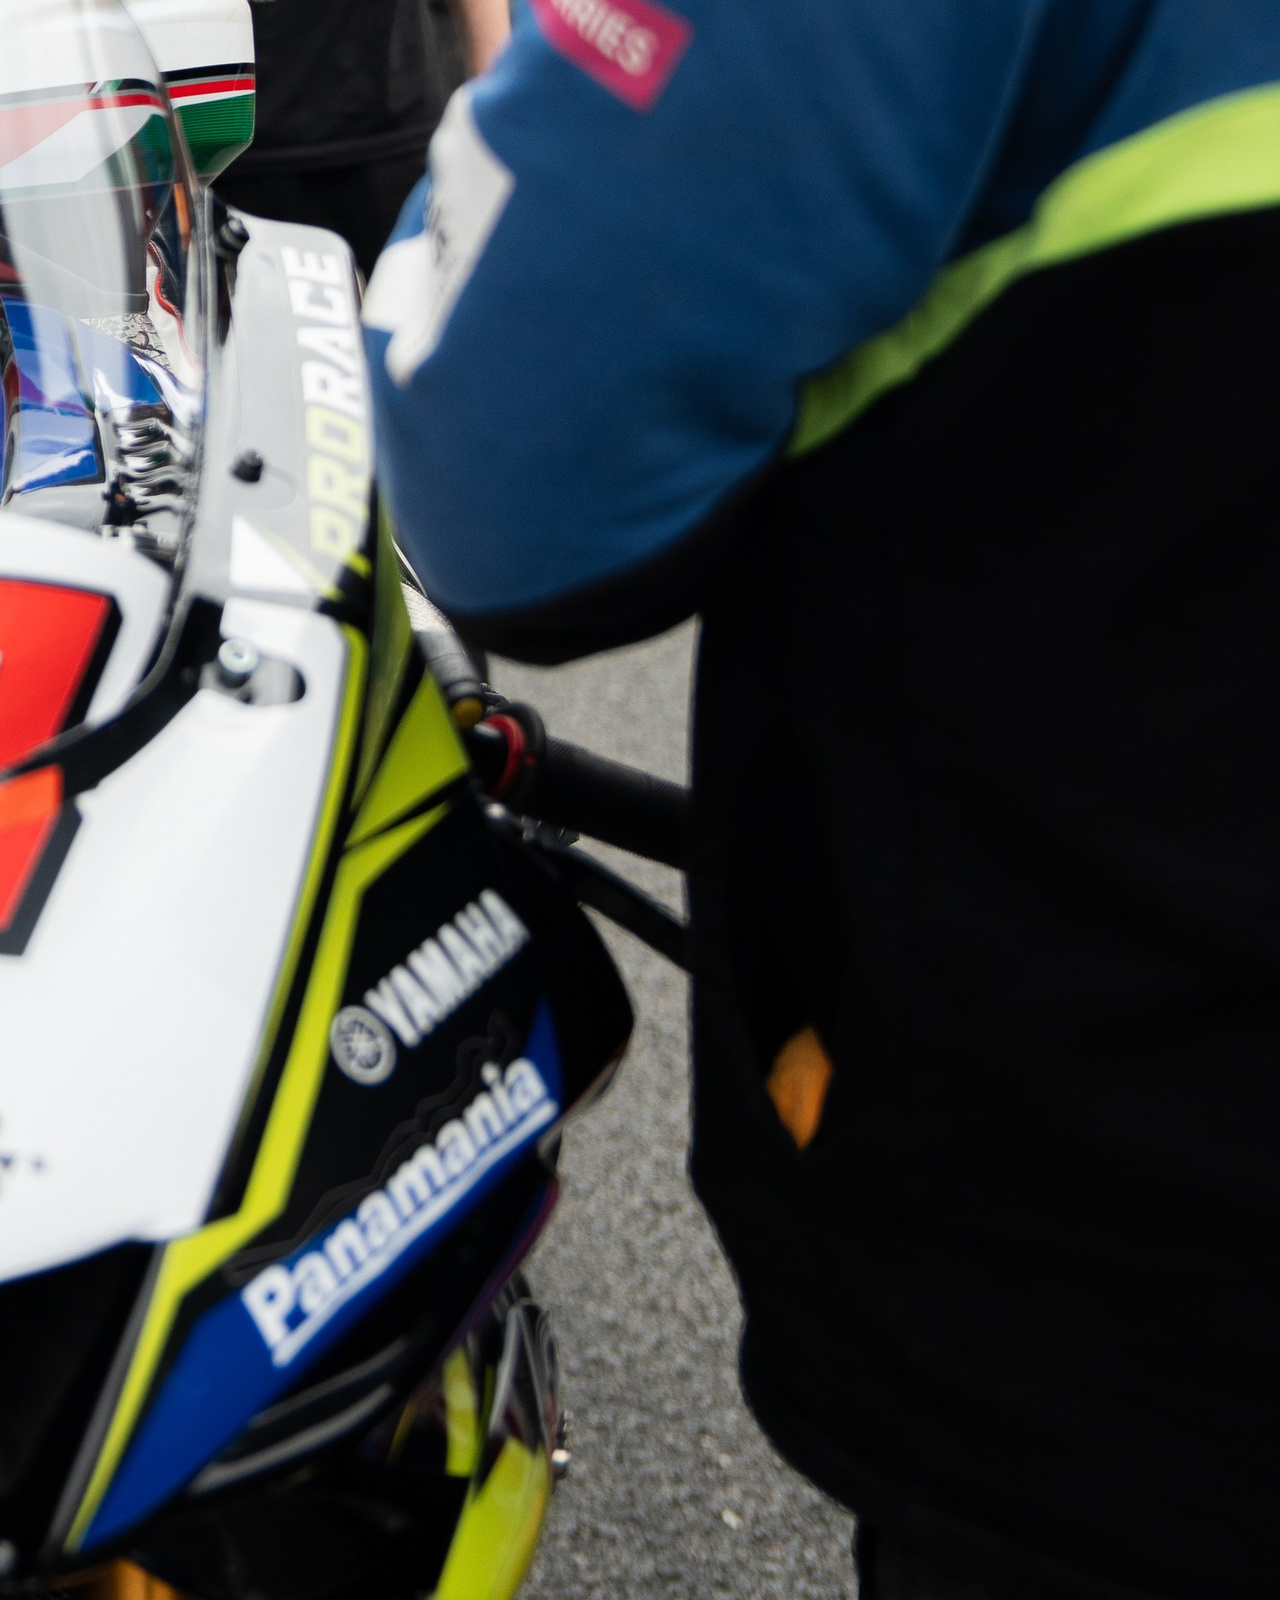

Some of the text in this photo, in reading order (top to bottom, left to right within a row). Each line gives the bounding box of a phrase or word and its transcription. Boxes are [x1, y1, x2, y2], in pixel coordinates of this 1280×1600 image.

[279, 244, 369, 564] PRORACE
[363, 887, 530, 1049] YAMAHA
[240, 1056, 553, 1352] Panamania
